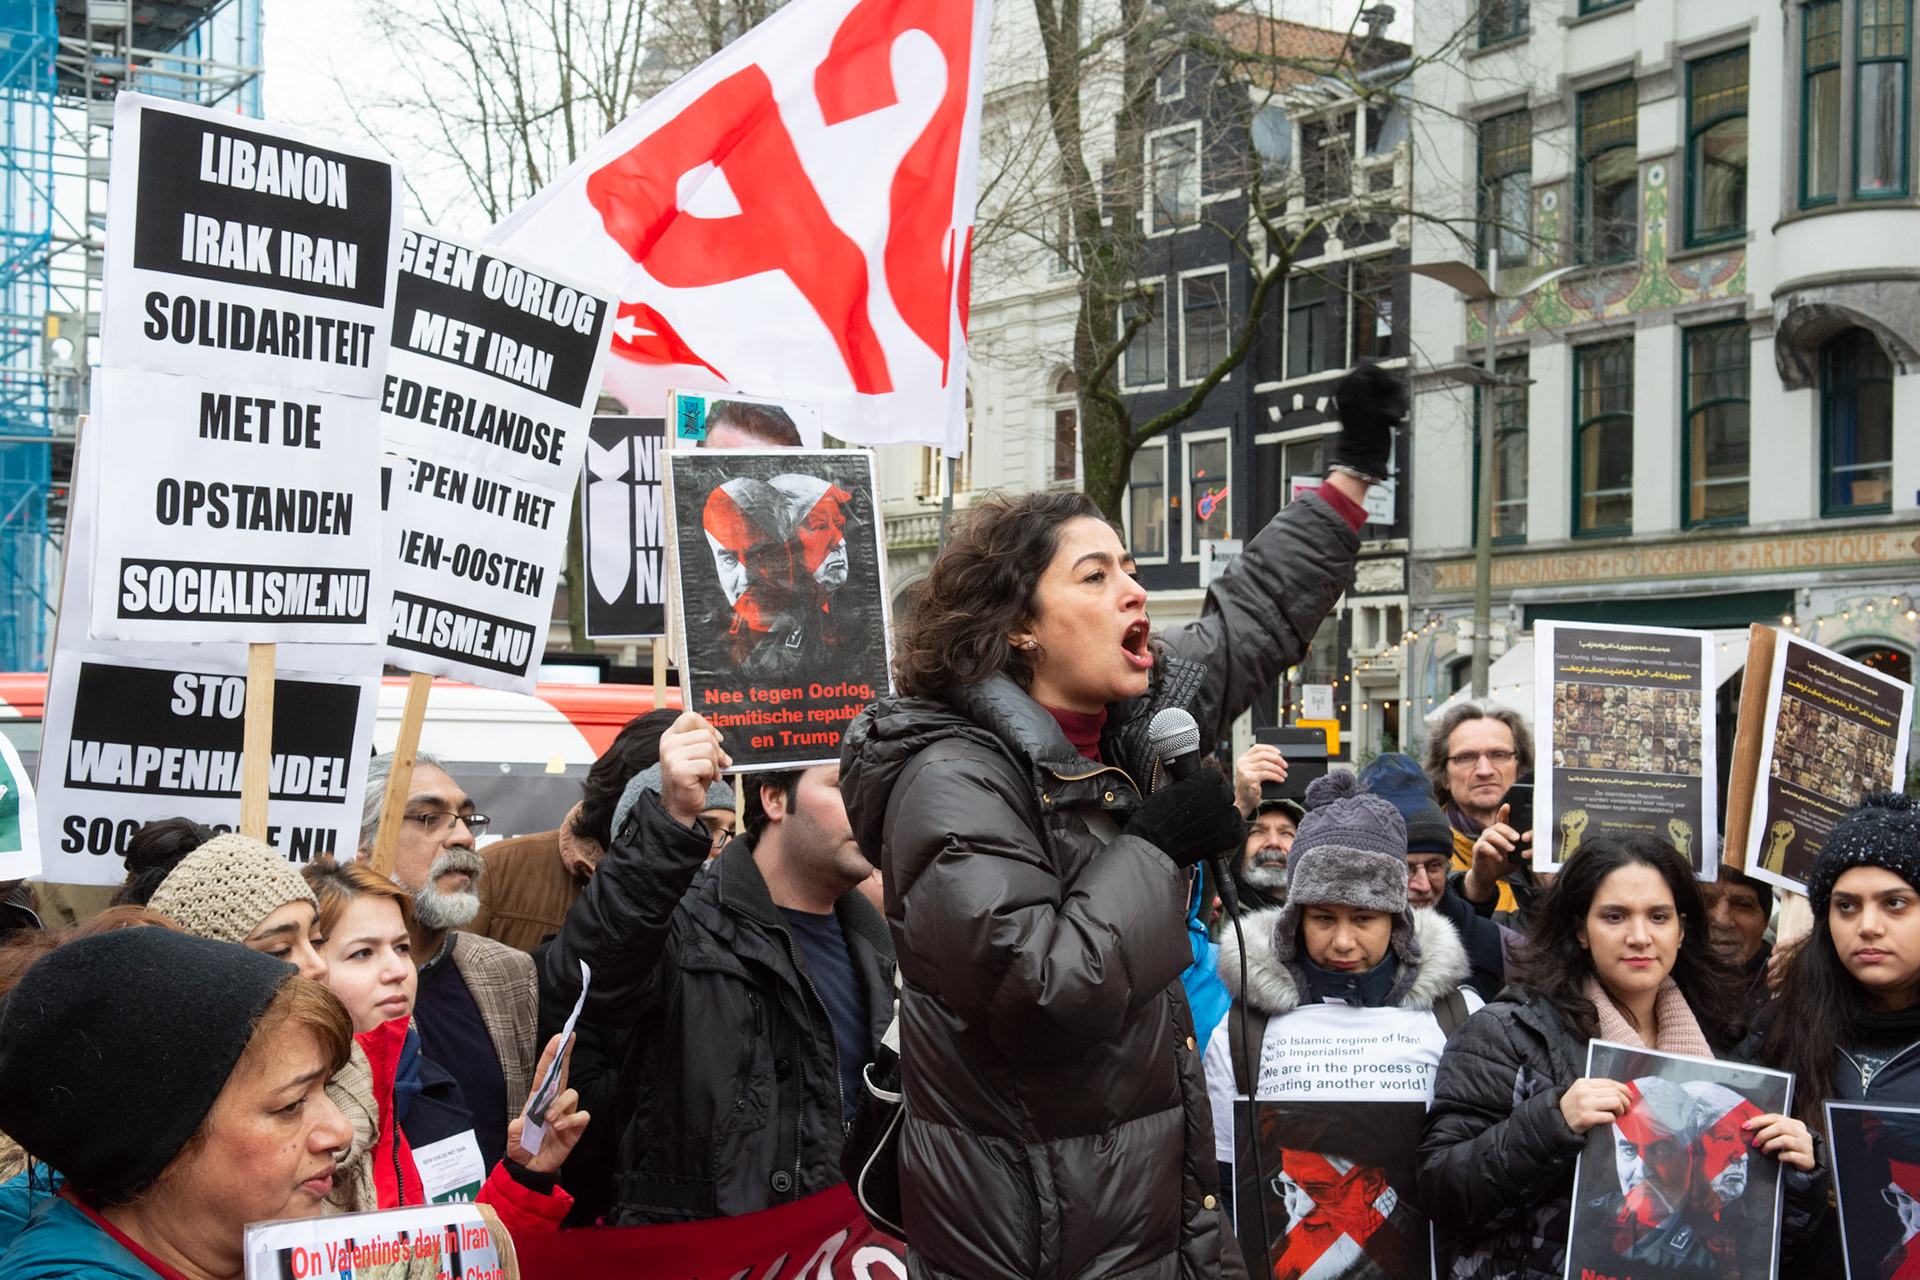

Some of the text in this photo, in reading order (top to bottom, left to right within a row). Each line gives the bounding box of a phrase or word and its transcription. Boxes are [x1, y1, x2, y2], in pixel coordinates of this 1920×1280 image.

[200, 131, 348, 210] LIBANON
[181, 212, 358, 290] IRAK IRAN
[399, 229, 598, 336] GEEN OORLOG
[143, 291, 376, 369] SOLIDARITEIT
[408, 308, 554, 391] MET IRAN
[199, 391, 322, 450] MET DE
[381, 374, 567, 466] EDERLANDSE
[156, 477, 354, 536] OPSTANDEN
[471, 477, 512, 517] UIT
[512, 490, 556, 530] HET
[1457, 554, 1598, 587] BUTINGHAUSEN
[1612, 544, 1734, 576] FOTOGRAFIE
[1751, 534, 1888, 569] ARTISTIQUE
[122, 564, 367, 618] SOCIALISME.NU
[391, 599, 532, 667] ALISME.NU
[171, 673, 248, 720] STO
[700, 704, 865, 727] slamitische republi
[704, 682, 876, 705] Nee tegen Oorlog,
[751, 731, 840, 749] en Trump
[1276, 1050, 1286, 1058] to
[1289, 1047, 1365, 1058] Imperialism!
[1290, 1036, 1333, 1046] Islamic
[1336, 1036, 1379, 1047] regime
[1382, 1033, 1394, 1043] of
[1264, 1062, 1430, 1079] We are in the process of
[1264, 1078, 1428, 1095] creating another world!
[291, 1223, 489, 1279] On Valentine's day in Iran
